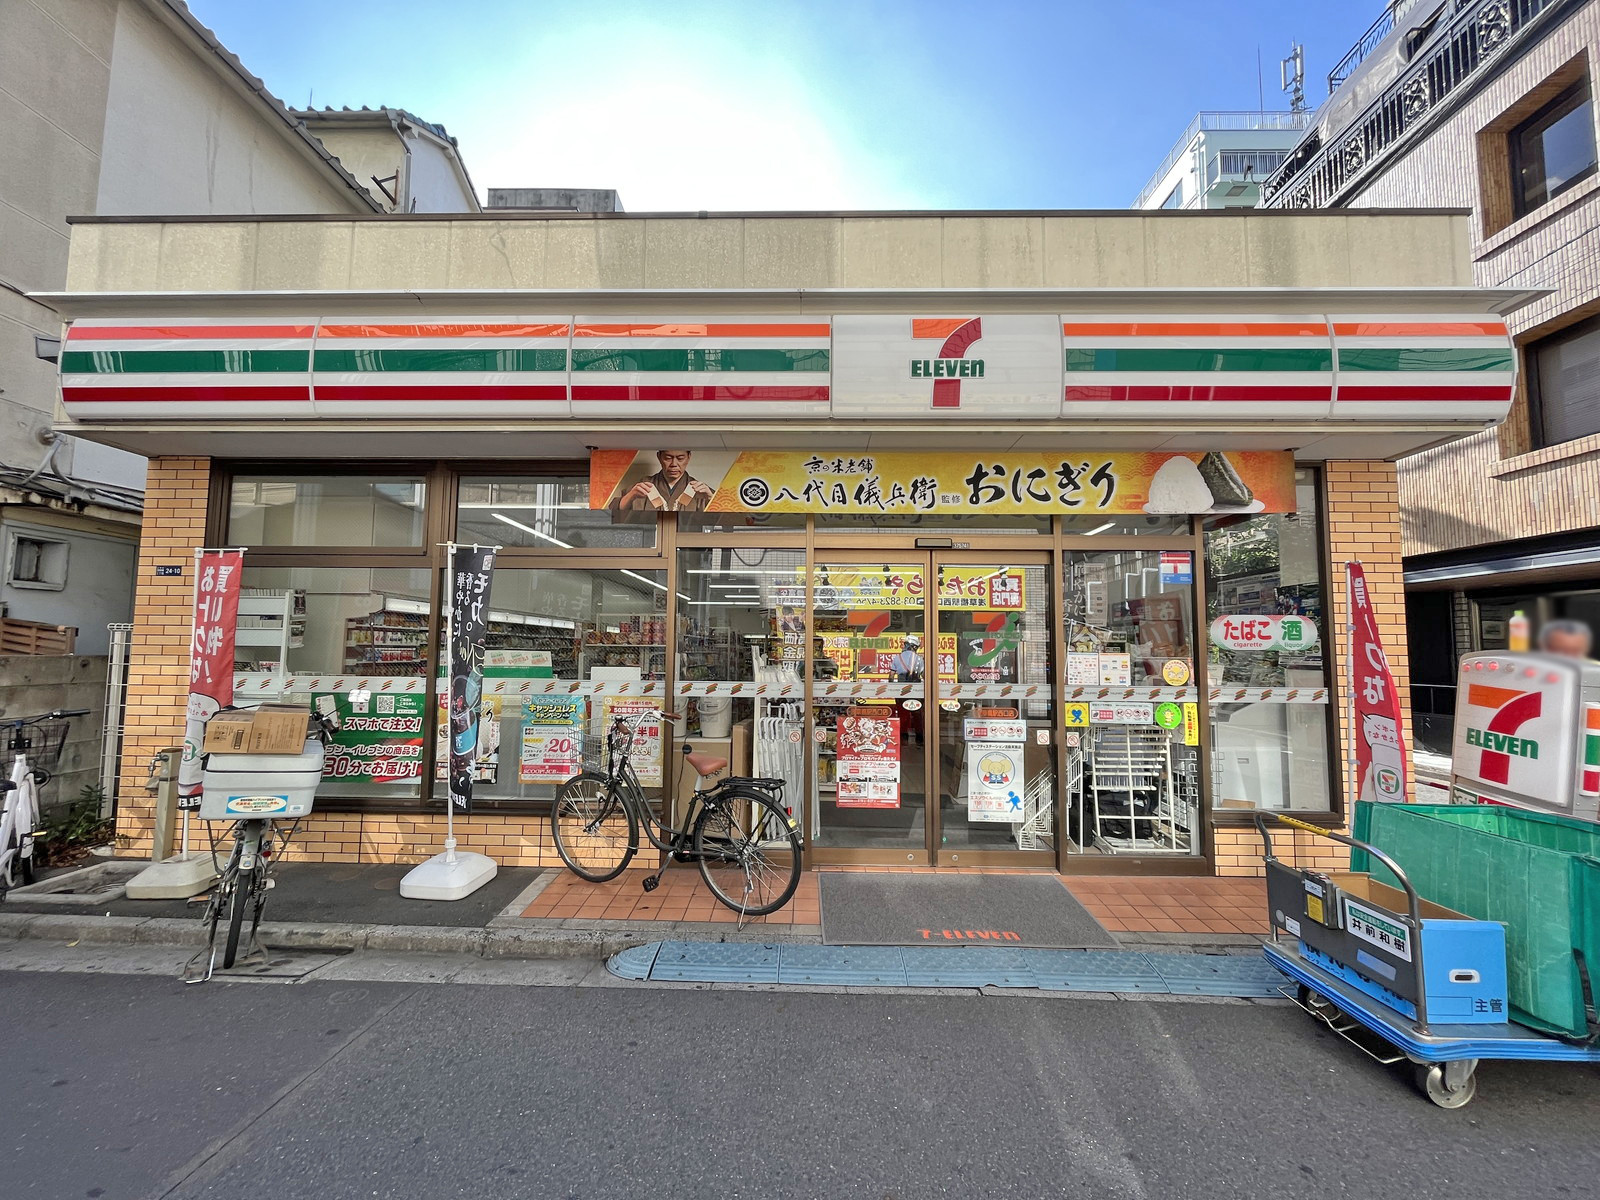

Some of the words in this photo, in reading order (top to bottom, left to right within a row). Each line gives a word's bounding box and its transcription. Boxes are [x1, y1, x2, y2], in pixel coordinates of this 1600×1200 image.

[804, 456, 874, 474] 京の米老舗
[774, 476, 937, 510] 八代目儀兵衛
[965, 462, 1115, 507] おにぎり
[1224, 620, 1272, 640] たばこ
[1281, 620, 1302, 641] 酒
[528, 704, 577, 712] キャッシュレス
[344, 718, 421, 731] スマホで注文!
[548, 738, 571, 753] 20
[1475, 999, 1502, 1012] 主管
